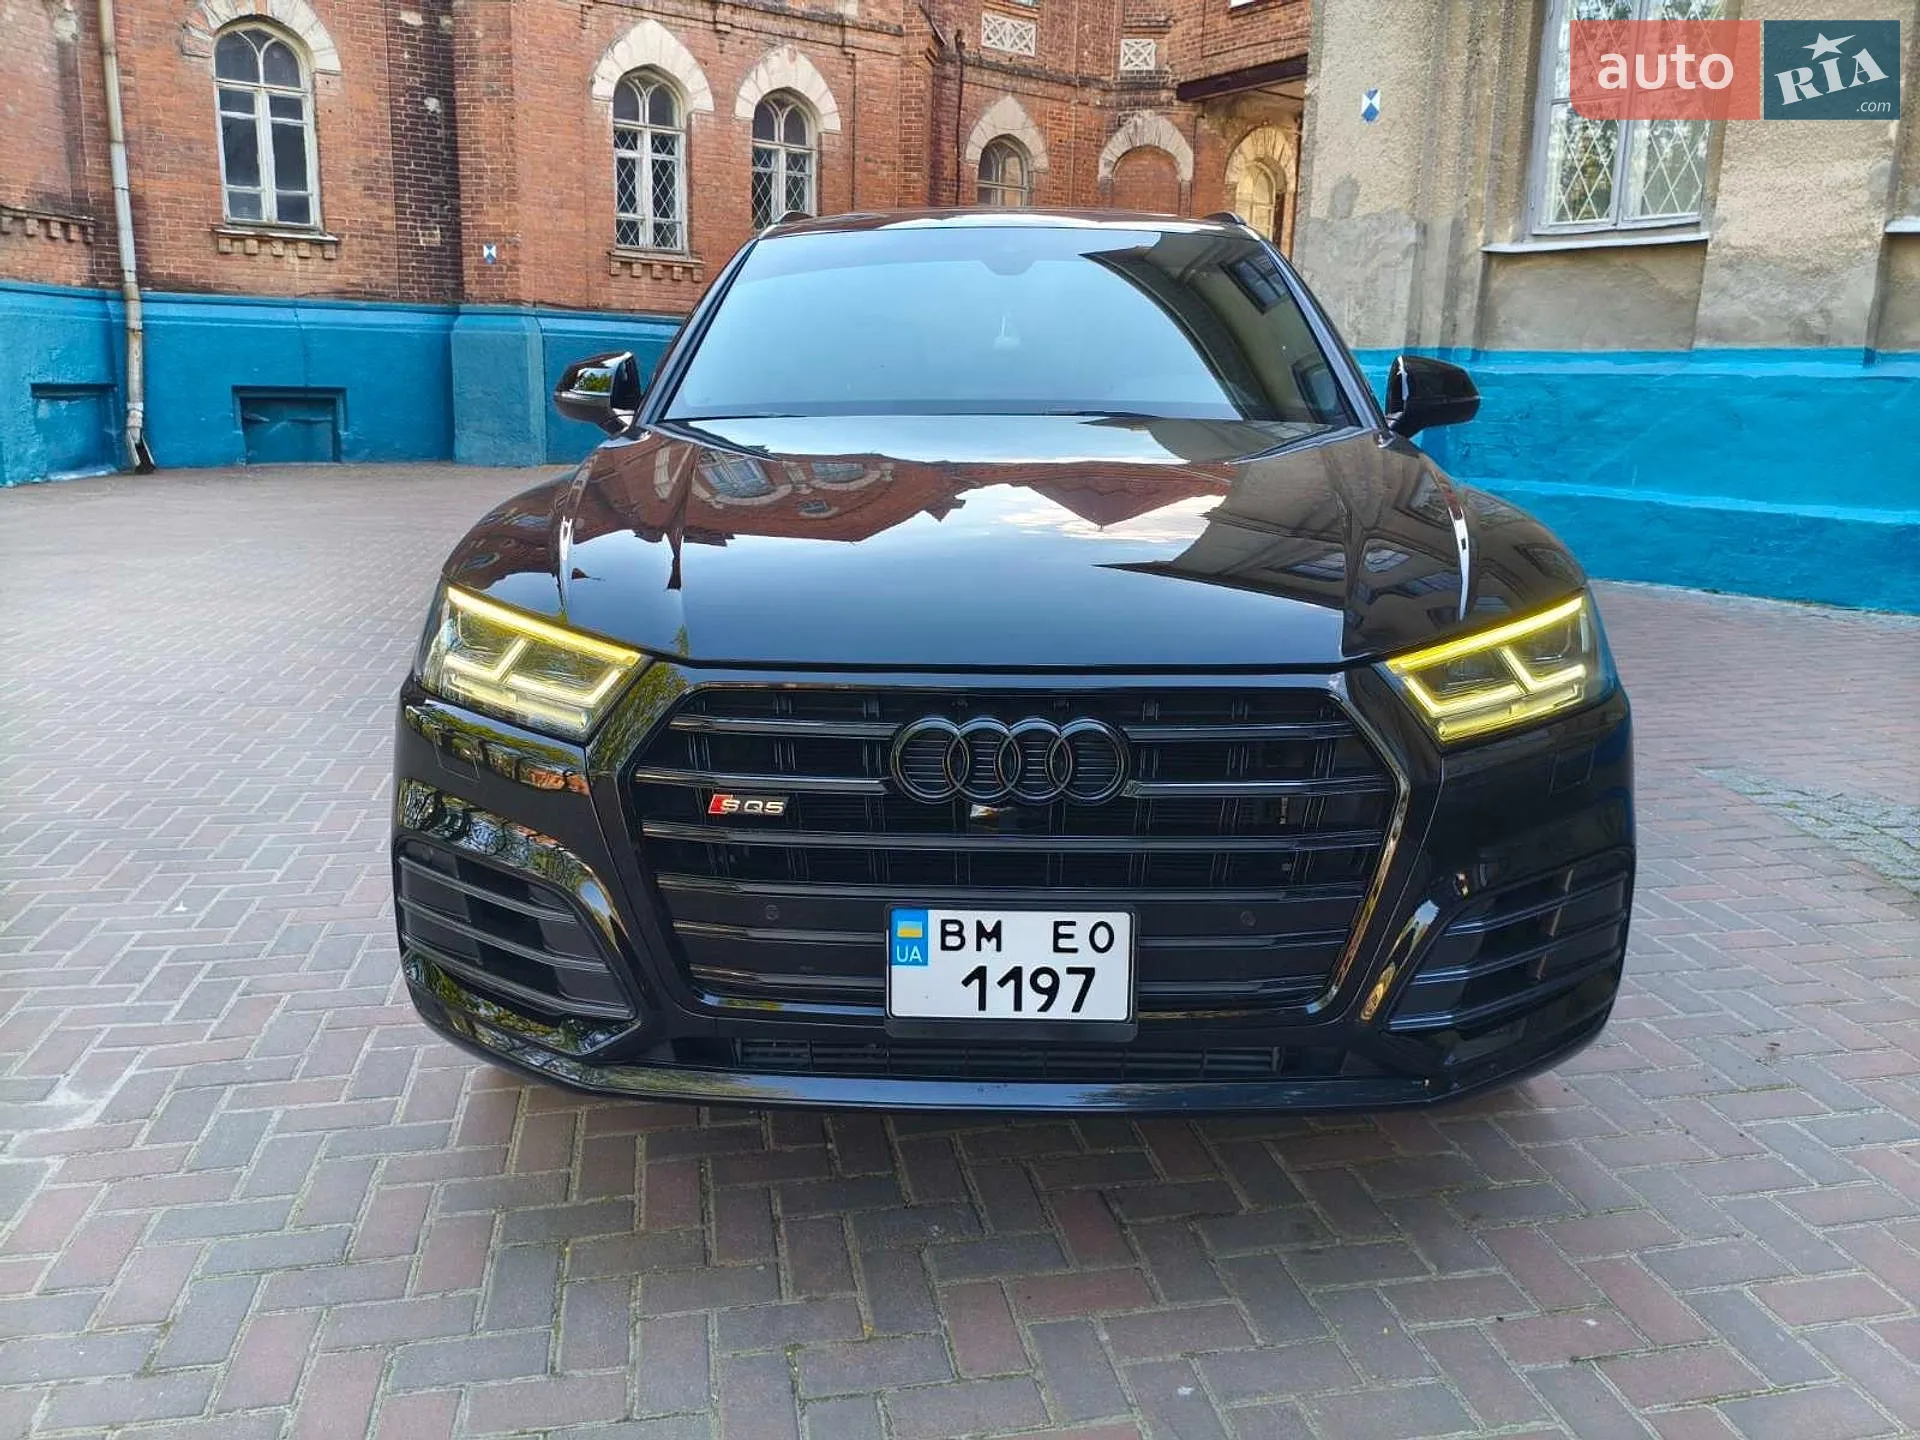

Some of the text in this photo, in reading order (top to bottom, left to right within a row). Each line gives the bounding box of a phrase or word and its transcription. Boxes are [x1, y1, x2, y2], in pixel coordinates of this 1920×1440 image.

[720, 798, 785, 814] SQ5
[940, 919, 1002, 952] BM
[896, 944, 923, 963] UA
[961, 965, 1096, 1013] 1197
